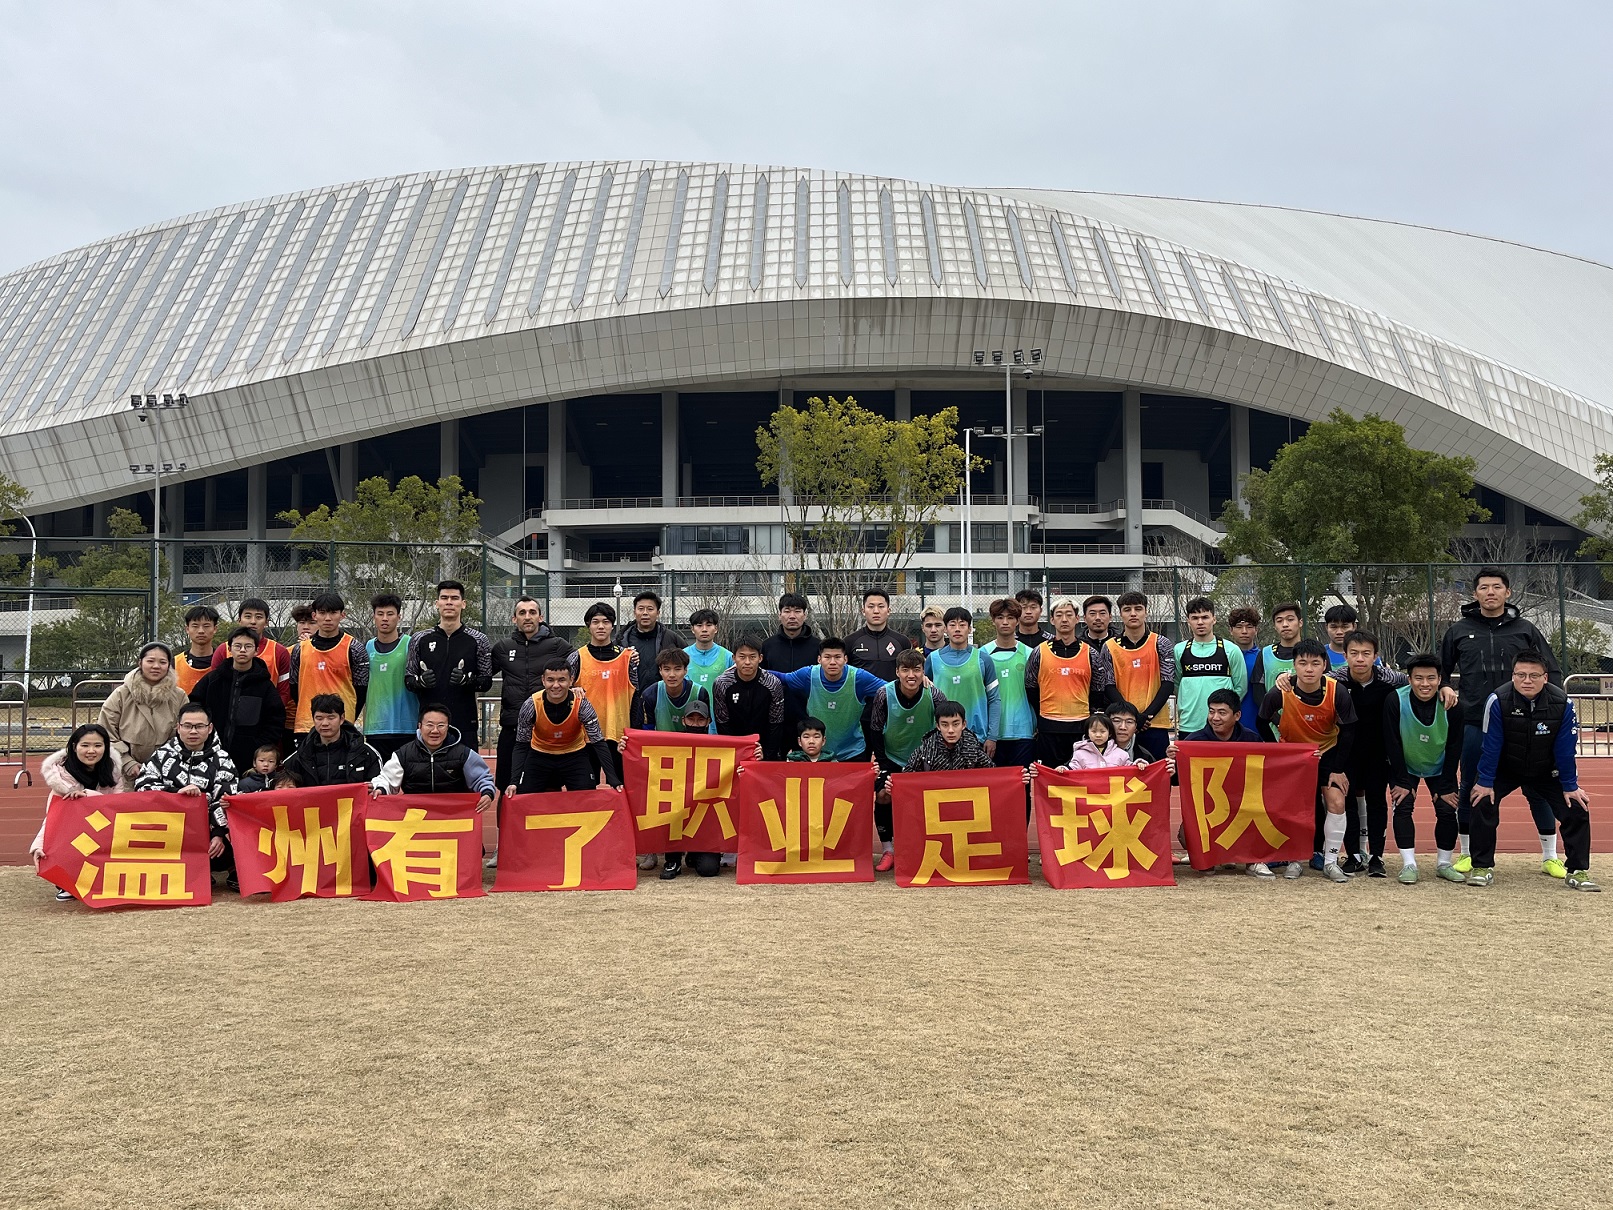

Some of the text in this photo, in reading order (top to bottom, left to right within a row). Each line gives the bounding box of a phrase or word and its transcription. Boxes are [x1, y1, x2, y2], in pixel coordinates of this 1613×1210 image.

[1049, 667, 1086, 676] K-SORT
[1185, 663, 1222, 671] K-SPORT
[638, 747, 735, 839] 职
[755, 778, 854, 874] 业
[913, 788, 1012, 884] 足
[1049, 777, 1156, 879] 球
[1191, 756, 1286, 851] 队
[74, 812, 192, 900] 温
[259, 799, 352, 894] 州
[366, 809, 473, 897] 有
[525, 811, 612, 888] 了
